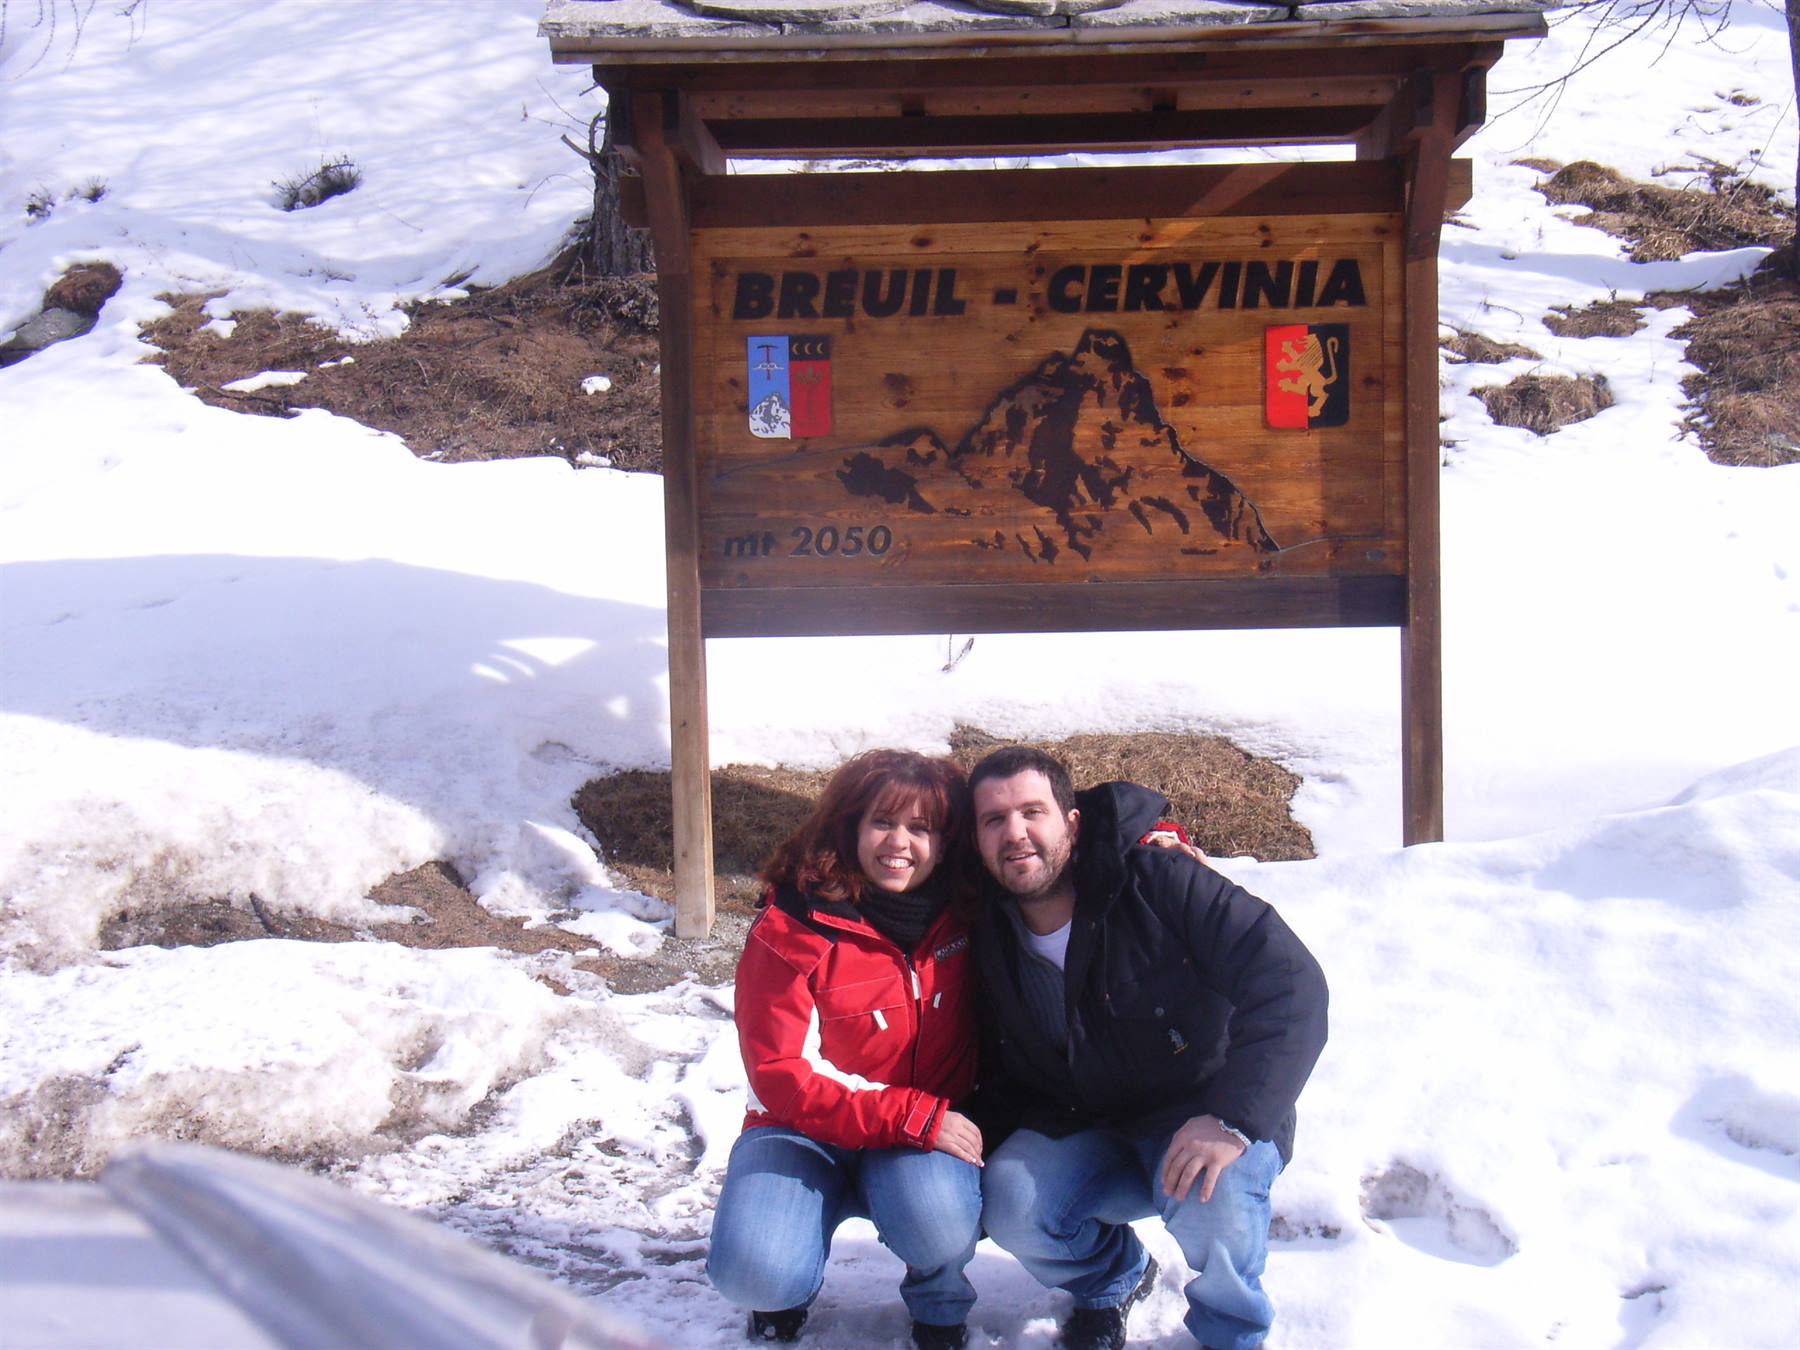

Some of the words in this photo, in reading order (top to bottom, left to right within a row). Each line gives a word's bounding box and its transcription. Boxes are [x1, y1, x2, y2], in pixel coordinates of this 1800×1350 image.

[733, 268, 967, 320] BREUIL
[994, 288, 1017, 305] -
[1049, 258, 1367, 314] CERVINIA
[724, 531, 775, 557] mt
[789, 525, 892, 557] 2050
